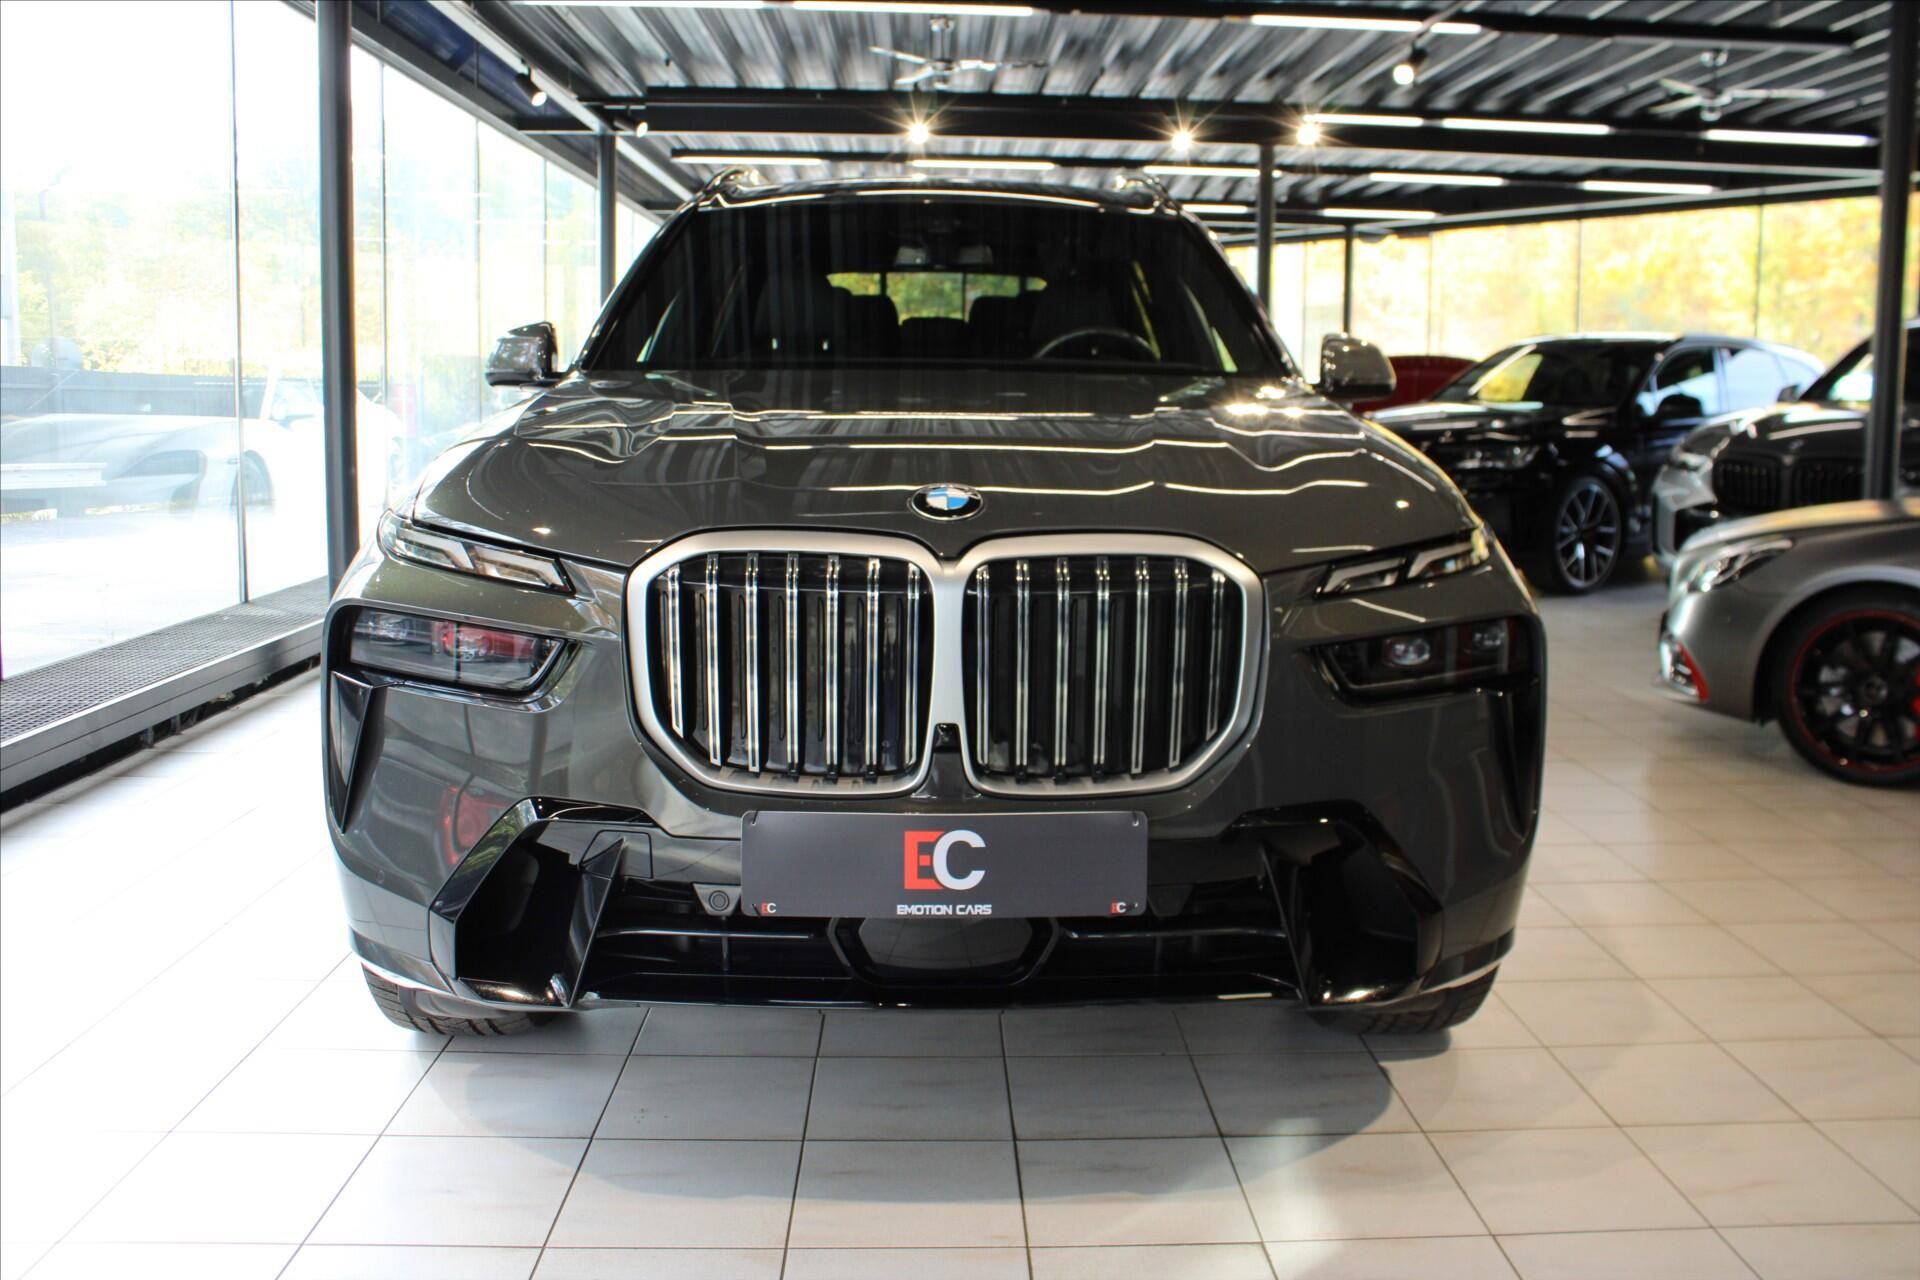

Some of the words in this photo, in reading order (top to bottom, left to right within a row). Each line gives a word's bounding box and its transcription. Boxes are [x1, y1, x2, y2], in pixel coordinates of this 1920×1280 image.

[904, 829, 986, 891] EC
[761, 902, 777, 914] EC
[896, 904, 953, 915] EMOTION
[956, 904, 993, 915] CARS
